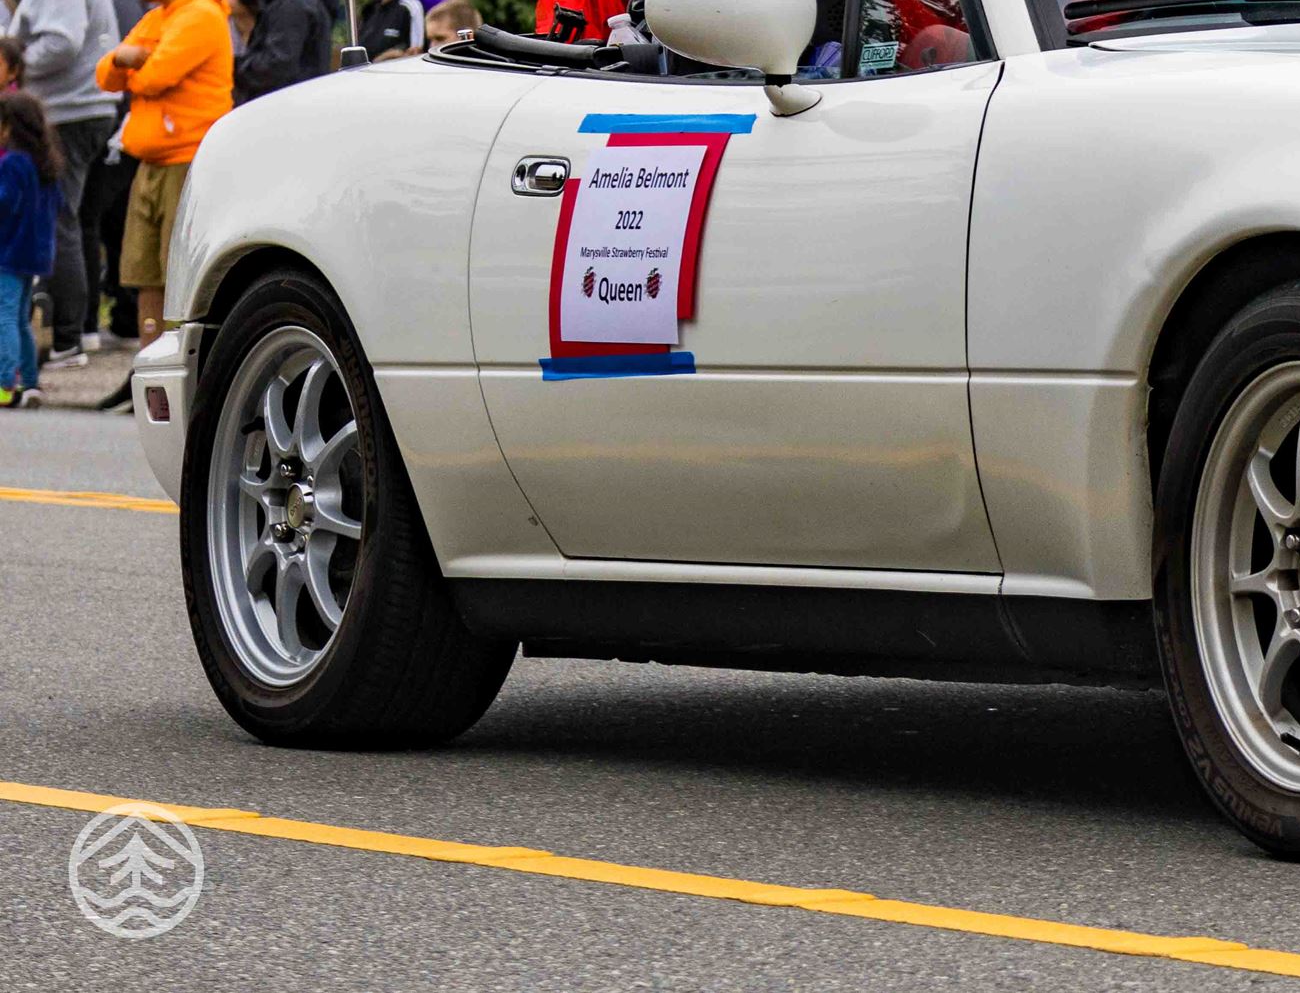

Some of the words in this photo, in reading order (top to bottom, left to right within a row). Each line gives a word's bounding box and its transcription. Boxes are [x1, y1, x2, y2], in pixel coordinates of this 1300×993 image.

[588, 167, 633, 188] Amelia
[635, 167, 689, 188] Belmont
[615, 210, 643, 229] 2022
[580, 246, 611, 260] Marysville
[611, 247, 645, 261] Strawberry
[645, 247, 668, 258] Festival
[598, 277, 642, 304] Queen
